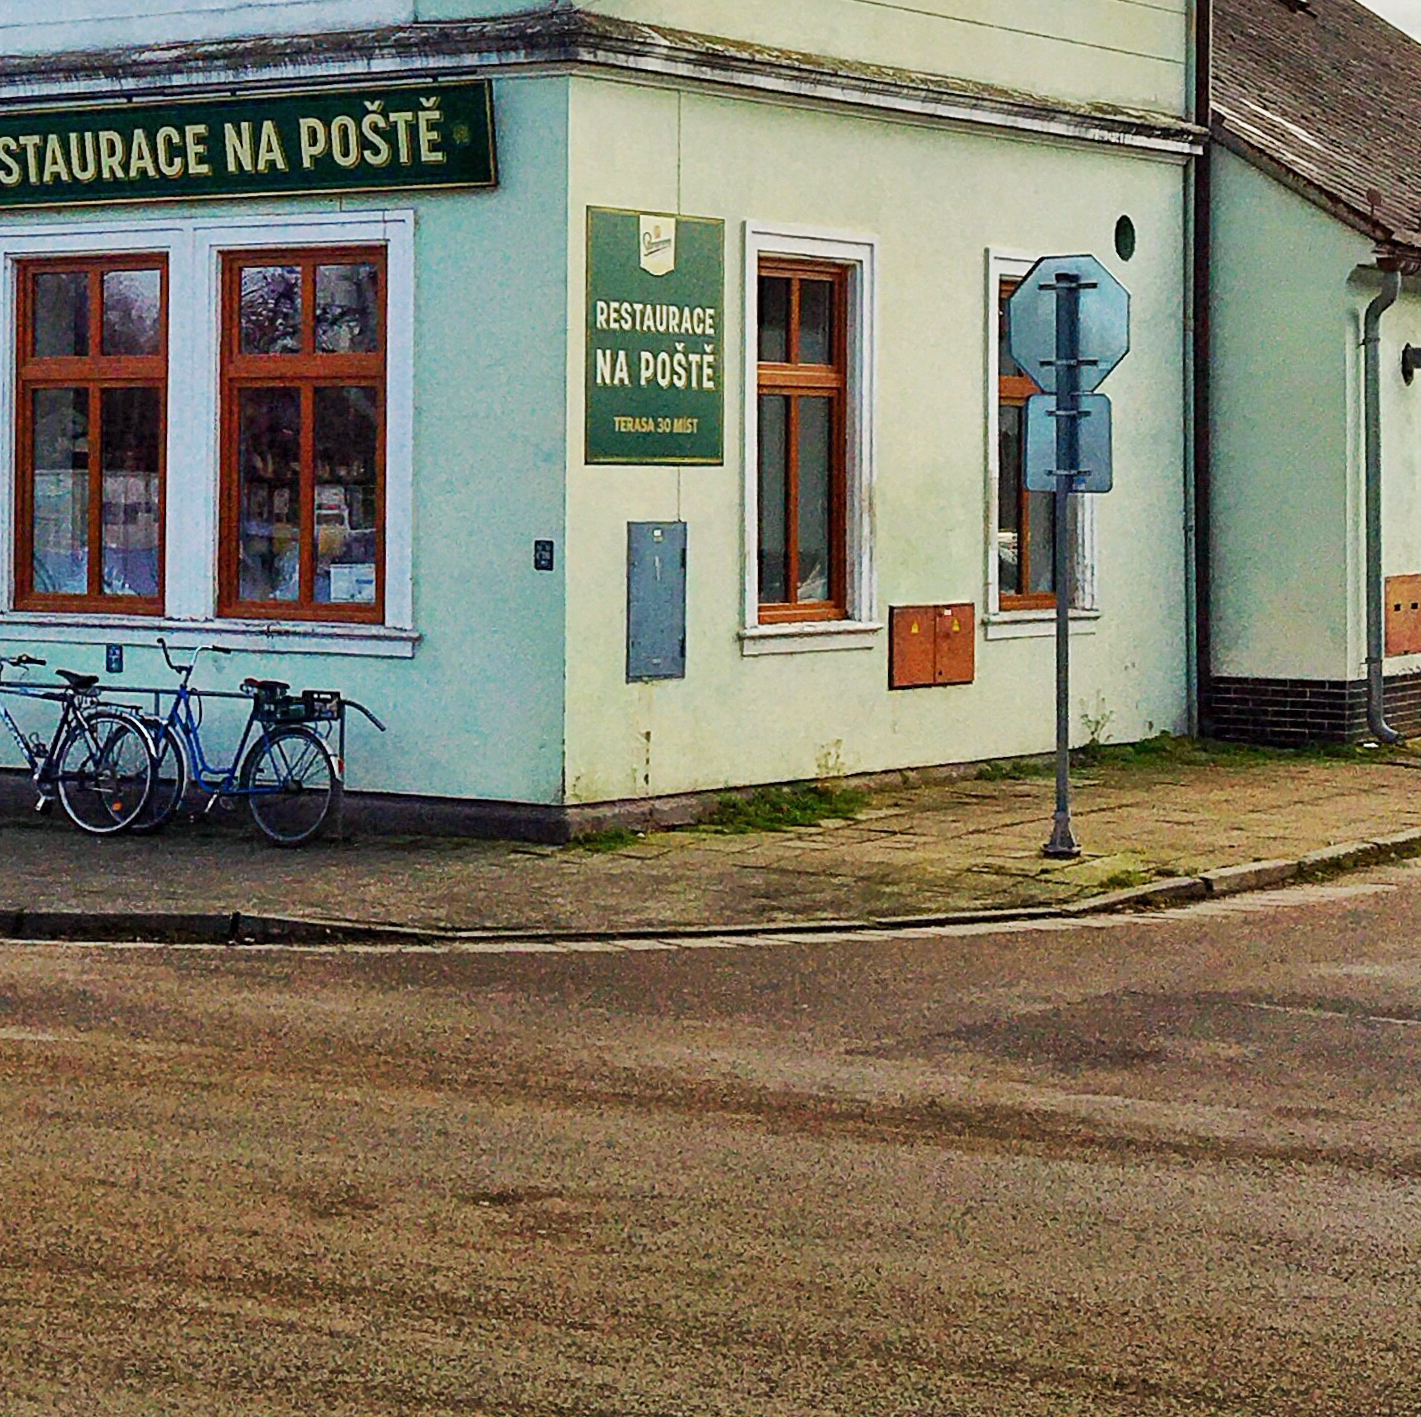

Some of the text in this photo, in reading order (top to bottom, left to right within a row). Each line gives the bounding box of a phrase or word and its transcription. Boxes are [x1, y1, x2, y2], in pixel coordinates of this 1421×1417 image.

[225, 119, 288, 176] NA
[299, 97, 446, 170] POŠTĚ
[596, 300, 716, 336] RESTAURACE
[595, 341, 716, 390] NA POŠTĚ
[613, 416, 655, 433] TERASA
[657, 417, 672, 433] 30
